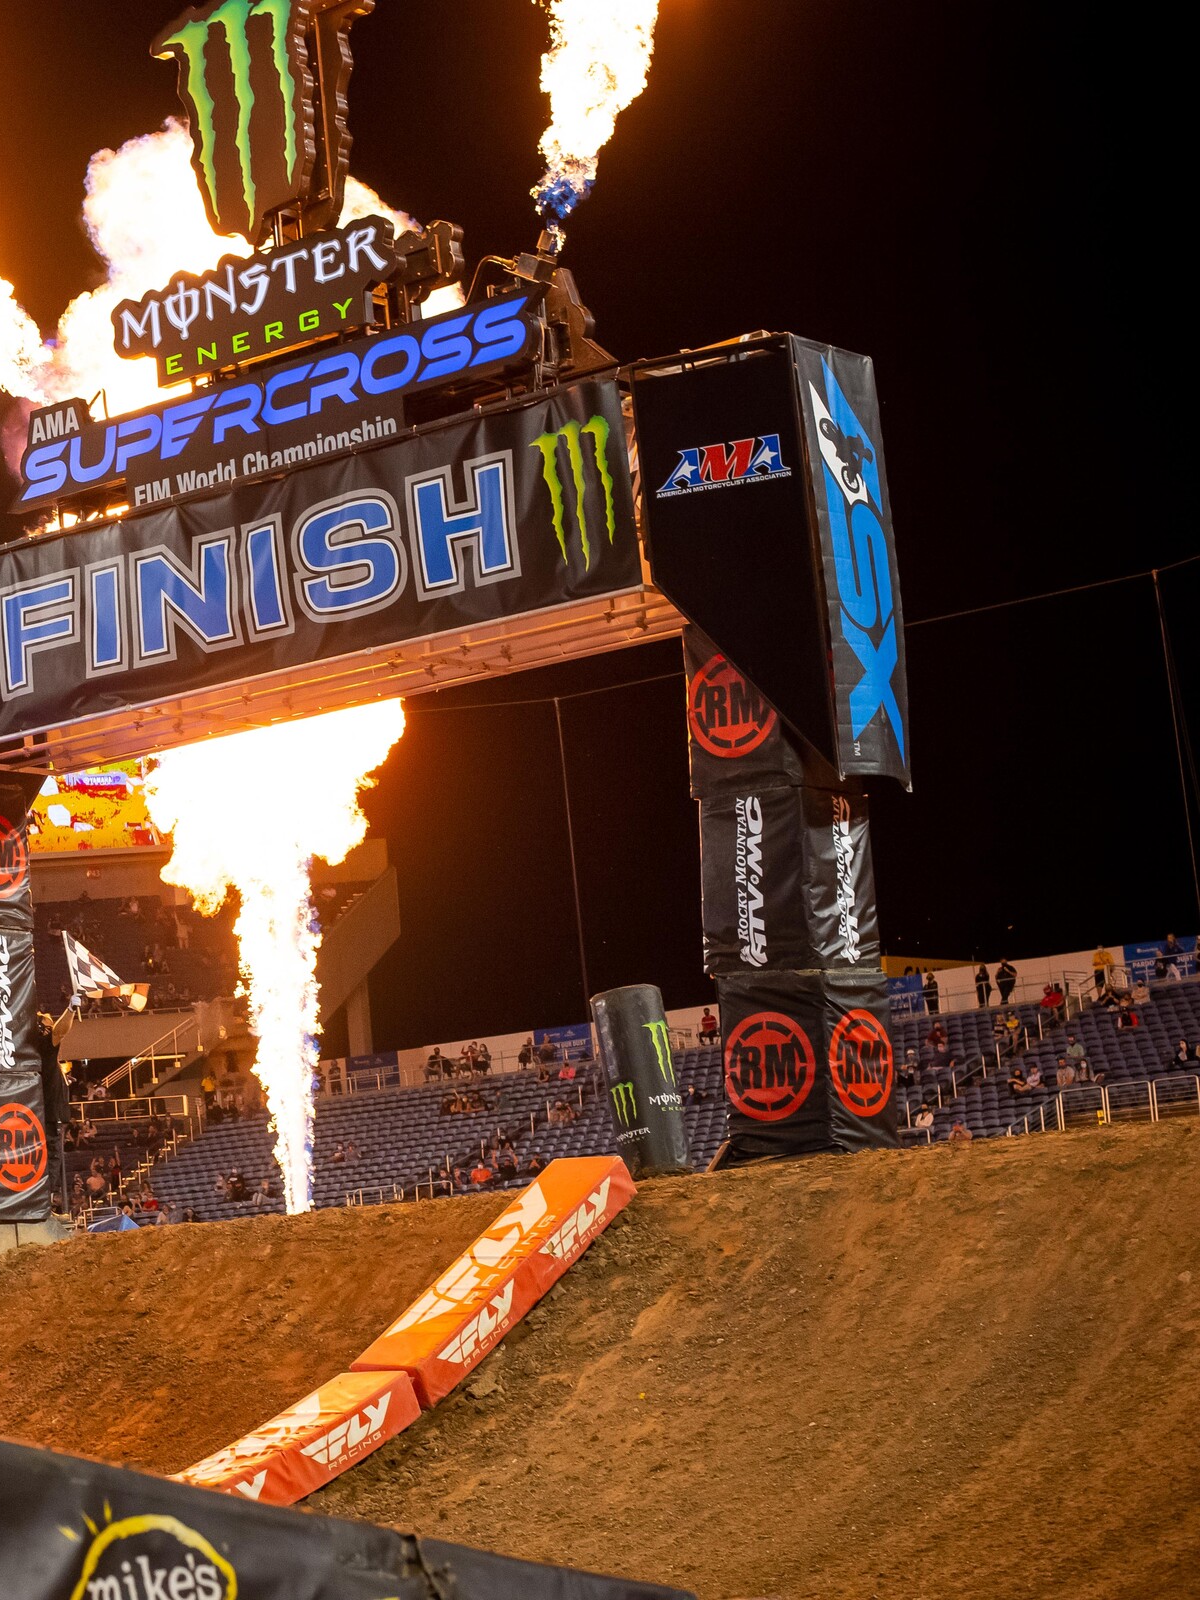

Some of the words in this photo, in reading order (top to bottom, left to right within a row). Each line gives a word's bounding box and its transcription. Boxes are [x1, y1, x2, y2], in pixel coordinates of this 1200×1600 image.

[118, 225, 388, 350] MONSTER
[166, 298, 354, 376] ENERGY
[21, 296, 528, 500] SUPERCROSS
[32, 406, 81, 445] AMA
[176, 458, 237, 493] World
[242, 416, 397, 475] Championship
[656, 433, 791, 493] AMA
[657, 487, 692, 499] AMERICAN
[693, 478, 745, 493] MOTORCYCLIST
[746, 470, 792, 484] ASSOCIATION
[735, 797, 747, 886] MOUNTAIN
[831, 795, 845, 885] MOUNTAIN
[737, 888, 750, 943] ROCKY
[836, 885, 848, 939] ROCKY
[538, 1176, 611, 1260] FLY
[564, 1213, 611, 1263] RACING
[385, 1182, 548, 1338] FLY
[463, 1214, 556, 1306] RACING
[436, 1278, 516, 1364] FLY
[464, 1318, 511, 1369] RACING
[300, 1391, 392, 1465] FLY
[328, 1431, 386, 1472] RACING
[87, 1553, 223, 1600] mike's
